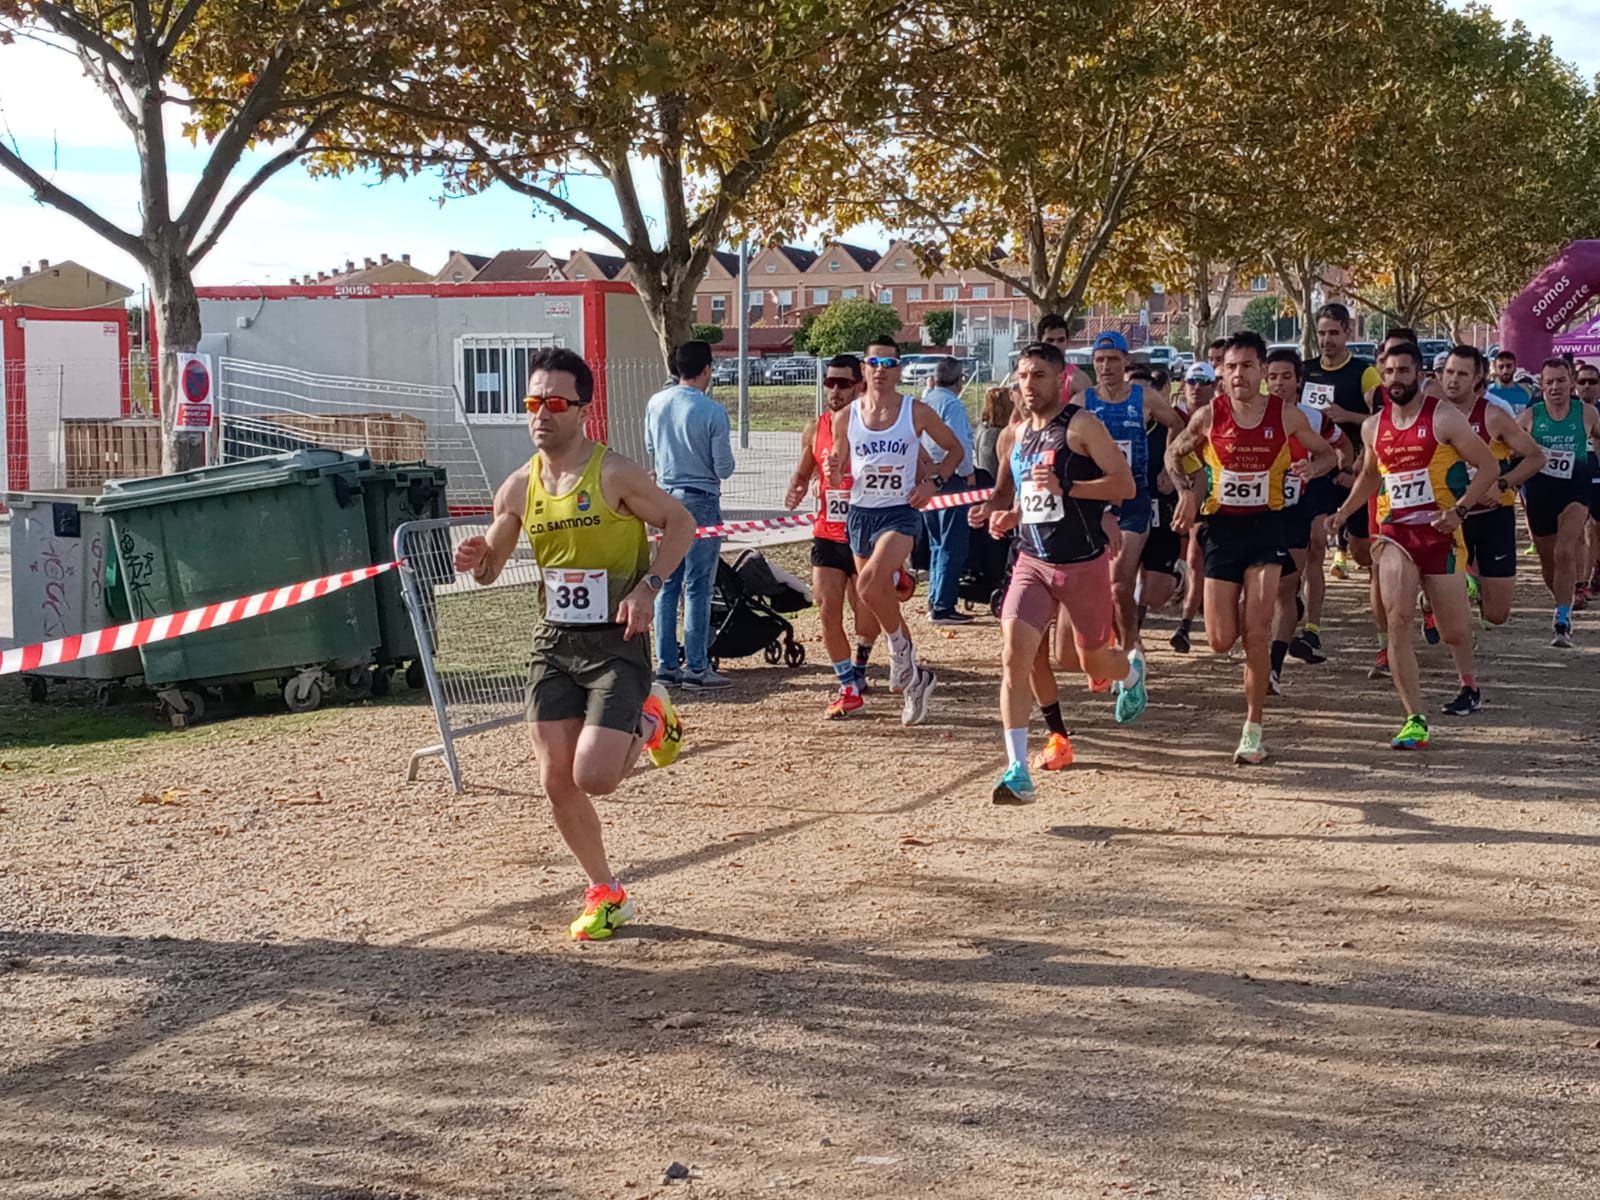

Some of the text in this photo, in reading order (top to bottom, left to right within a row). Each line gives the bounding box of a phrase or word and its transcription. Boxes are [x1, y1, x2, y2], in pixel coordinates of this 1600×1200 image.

[1532, 275, 1570, 317] somos
[1545, 284, 1590, 330] deporte
[1308, 391, 1327, 405] 59
[855, 438, 909, 457] CARRIÓN
[1549, 458, 1570, 472] 30
[865, 474, 903, 490] 278
[1223, 482, 1262, 498] 261
[1391, 480, 1426, 500] 277
[1024, 494, 1058, 512] 224
[529, 515, 601, 536] C.D. SANTINOS
[556, 585, 590, 610] 38
